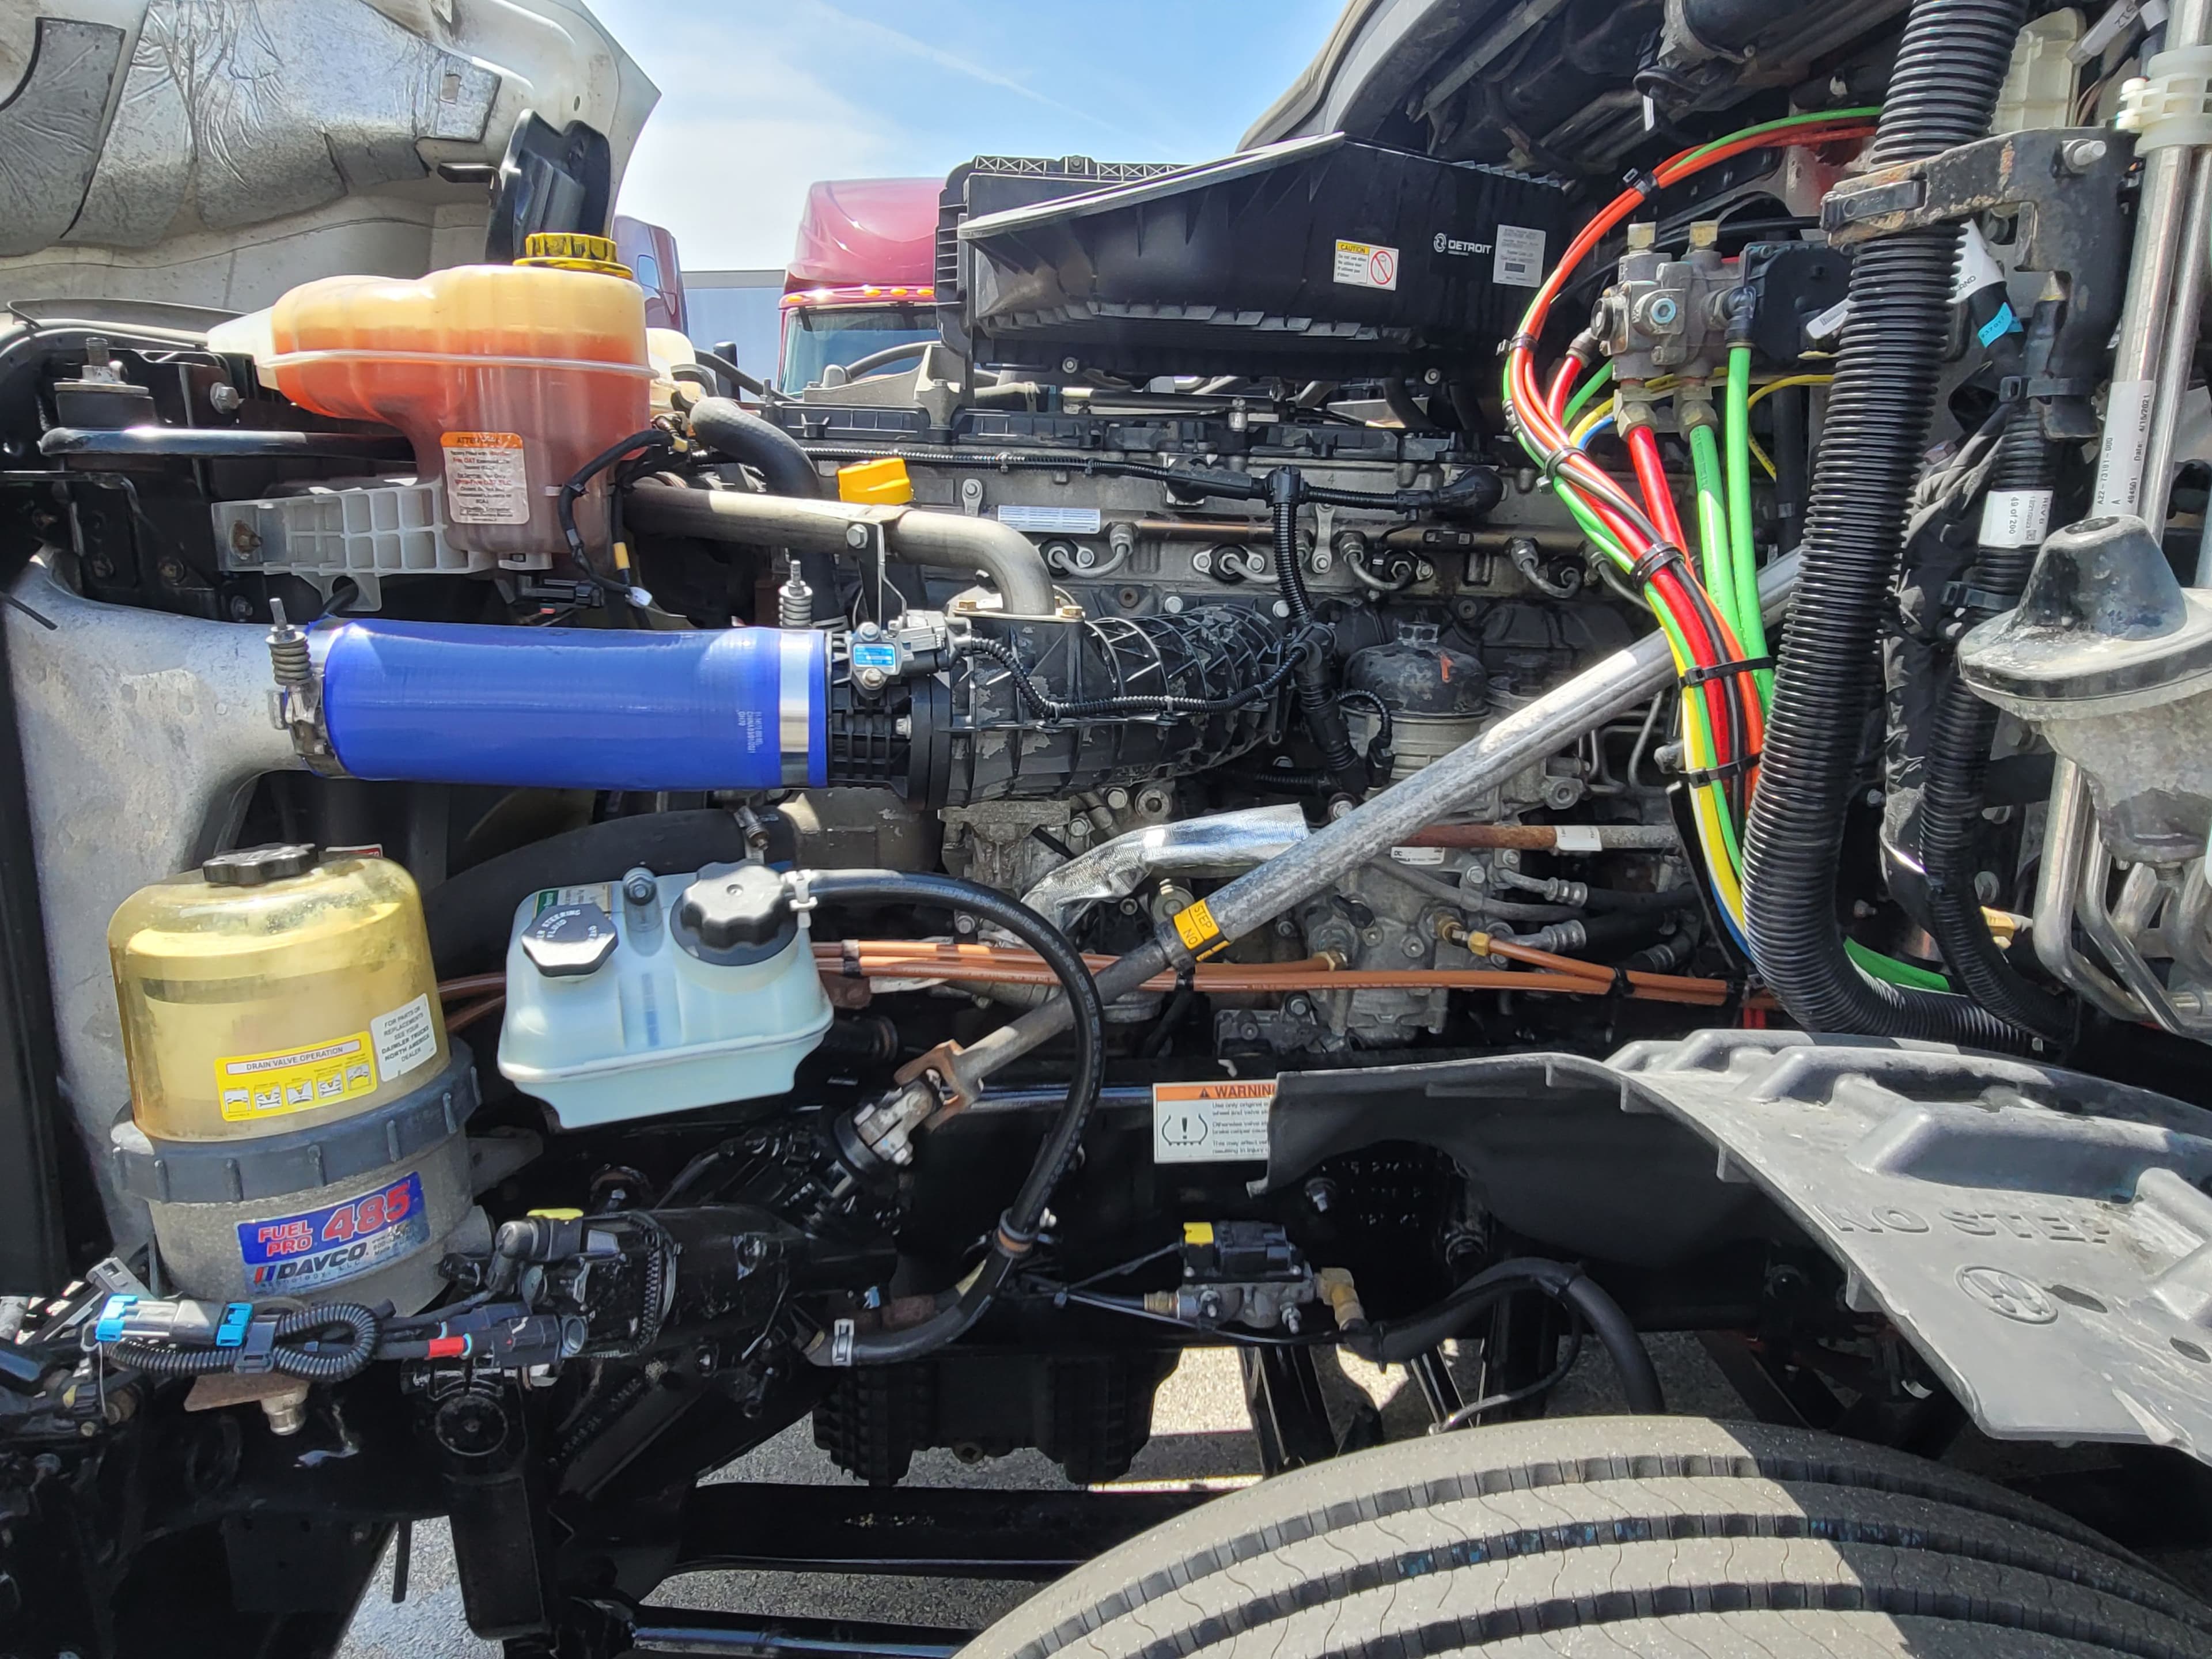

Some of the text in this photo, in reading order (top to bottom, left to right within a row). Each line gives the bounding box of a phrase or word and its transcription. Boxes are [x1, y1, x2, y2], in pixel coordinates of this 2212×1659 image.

[1340, 244, 1365, 253] CAUTION
[1448, 240, 1493, 254] DETROIT
[2009, 520, 2017, 535] 200
[541, 908, 581, 929] STEERING
[1194, 905, 1213, 928] STEP
[547, 918, 567, 938] FLUID
[1183, 928, 1198, 945] NO
[384, 1018, 397, 1028] FOR
[397, 1009, 414, 1022] PARTS
[384, 1012, 424, 1036] REPLACEMENTS
[406, 1023, 419, 1035] YOUR
[381, 1025, 430, 1054] DAIMLER TRUCKS
[384, 1047, 407, 1062] NORTH
[408, 1033, 430, 1050] AMERICA
[246, 1060, 271, 1071] DRAIN
[272, 1056, 297, 1067] VALVE
[300, 1046, 343, 1062] OPERATION
[401, 1046, 422, 1062] DEALER
[1215, 1084, 1275, 1097] WARNIN
[322, 1180, 411, 1243] 485
[258, 1219, 313, 1244] FUEL
[1813, 1203, 2111, 1244] NO STEP
[267, 1234, 313, 1257] PRO
[276, 1242, 368, 1280] DAVCO
